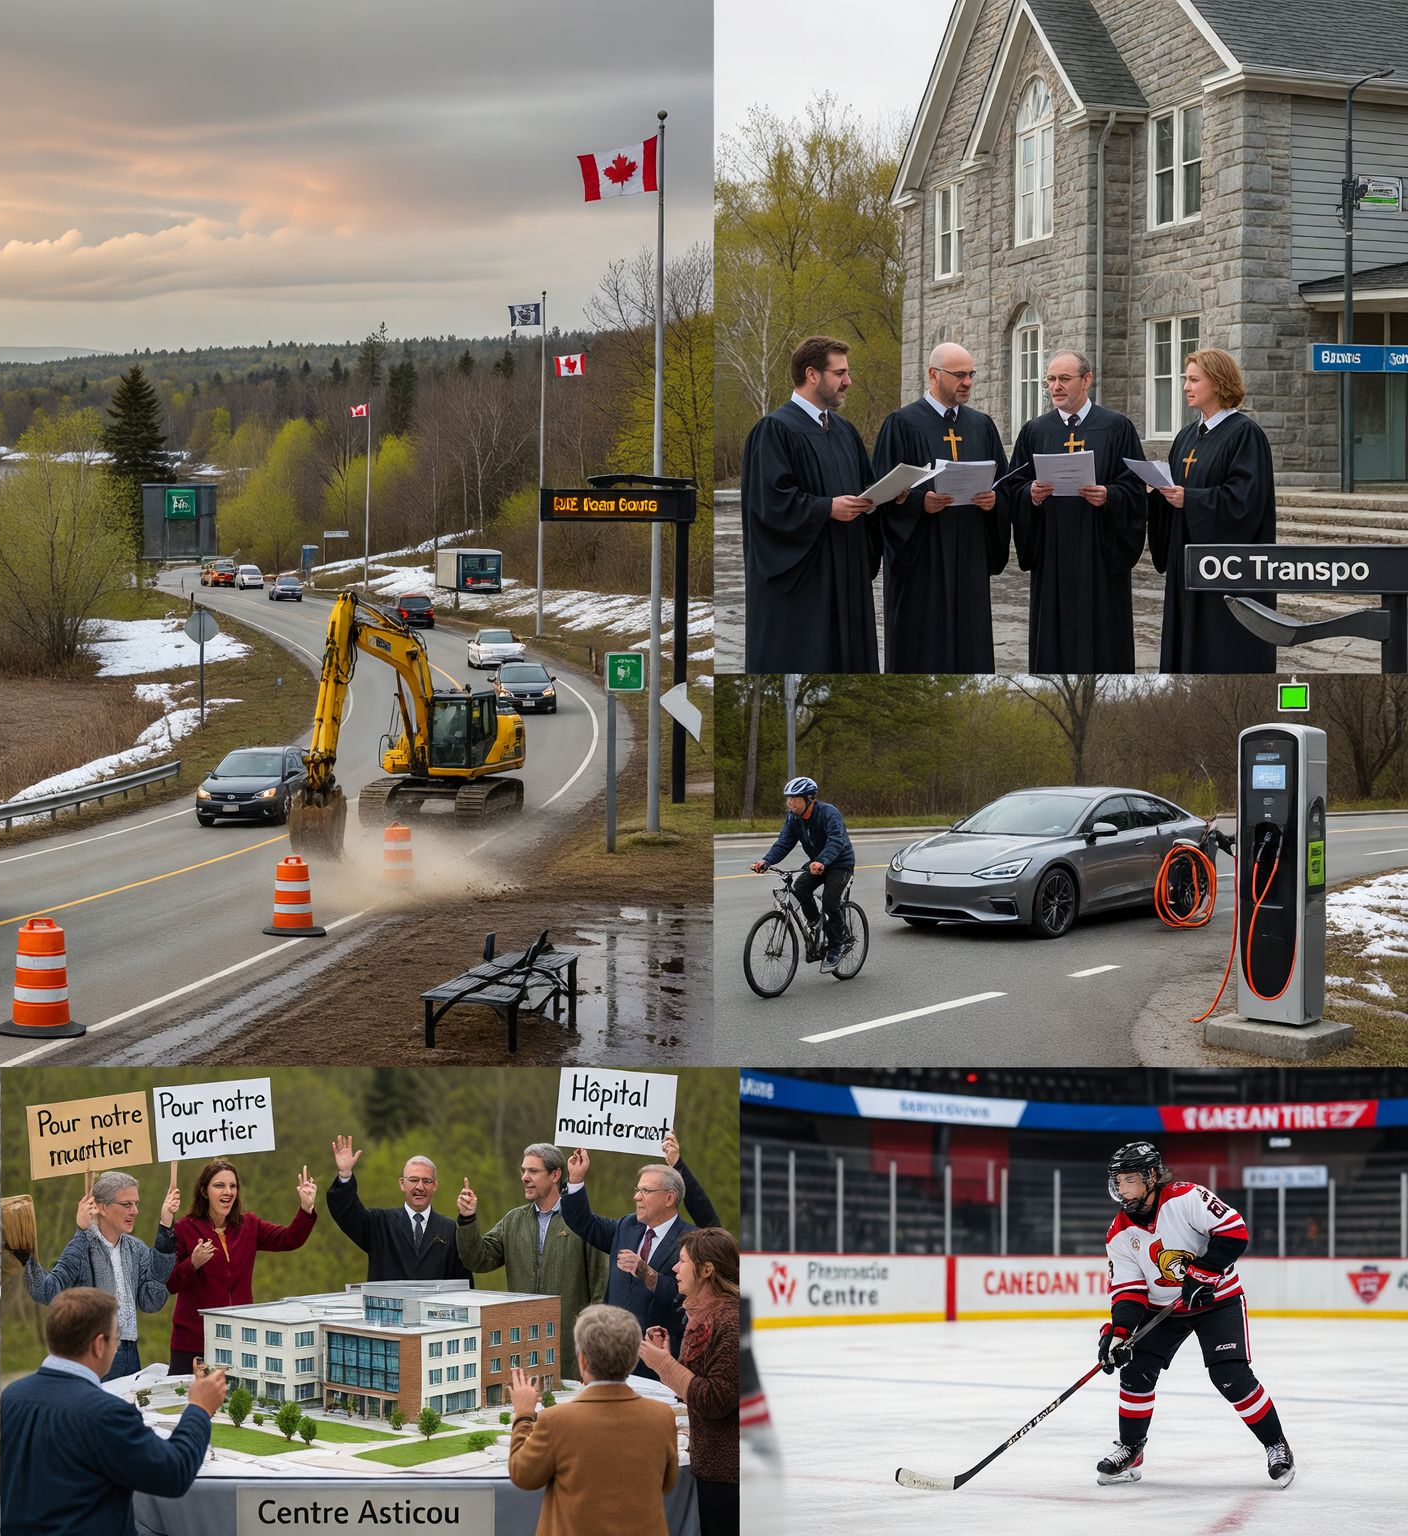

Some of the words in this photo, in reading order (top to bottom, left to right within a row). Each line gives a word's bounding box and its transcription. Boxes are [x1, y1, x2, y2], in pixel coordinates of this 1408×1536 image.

[1198, 555, 1242, 580] OC
[1249, 555, 1370, 587] Transpo
[158, 1092, 204, 1119] Pour
[212, 1089, 267, 1112] notre
[572, 1074, 650, 1112] Hôpital
[37, 1110, 81, 1138] Pour
[91, 1104, 143, 1130] notre
[172, 1119, 258, 1156] quartier
[807, 1283, 879, 1306] Centre
[258, 1500, 349, 1525] Centre
[358, 1499, 460, 1525] Asticou
